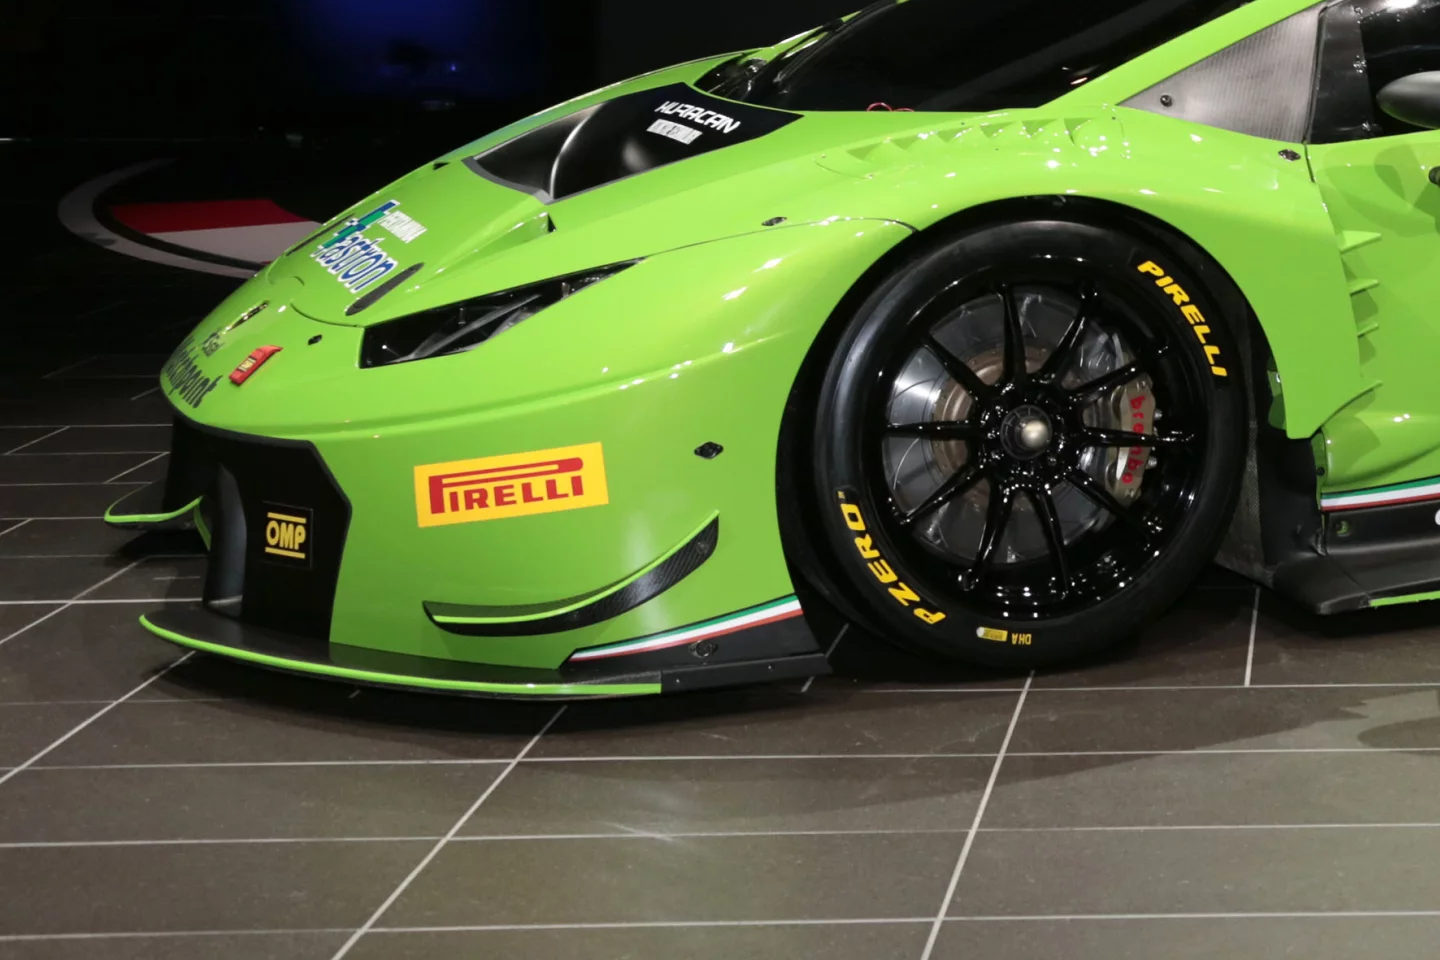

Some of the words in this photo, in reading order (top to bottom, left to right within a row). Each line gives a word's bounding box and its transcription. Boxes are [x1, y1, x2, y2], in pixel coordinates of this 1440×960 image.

[1137, 260, 1228, 377] PIRELLI
[428, 457, 584, 515] PIRELLI
[266, 519, 307, 551] OMP
[1011, 633, 1032, 646] DHA
